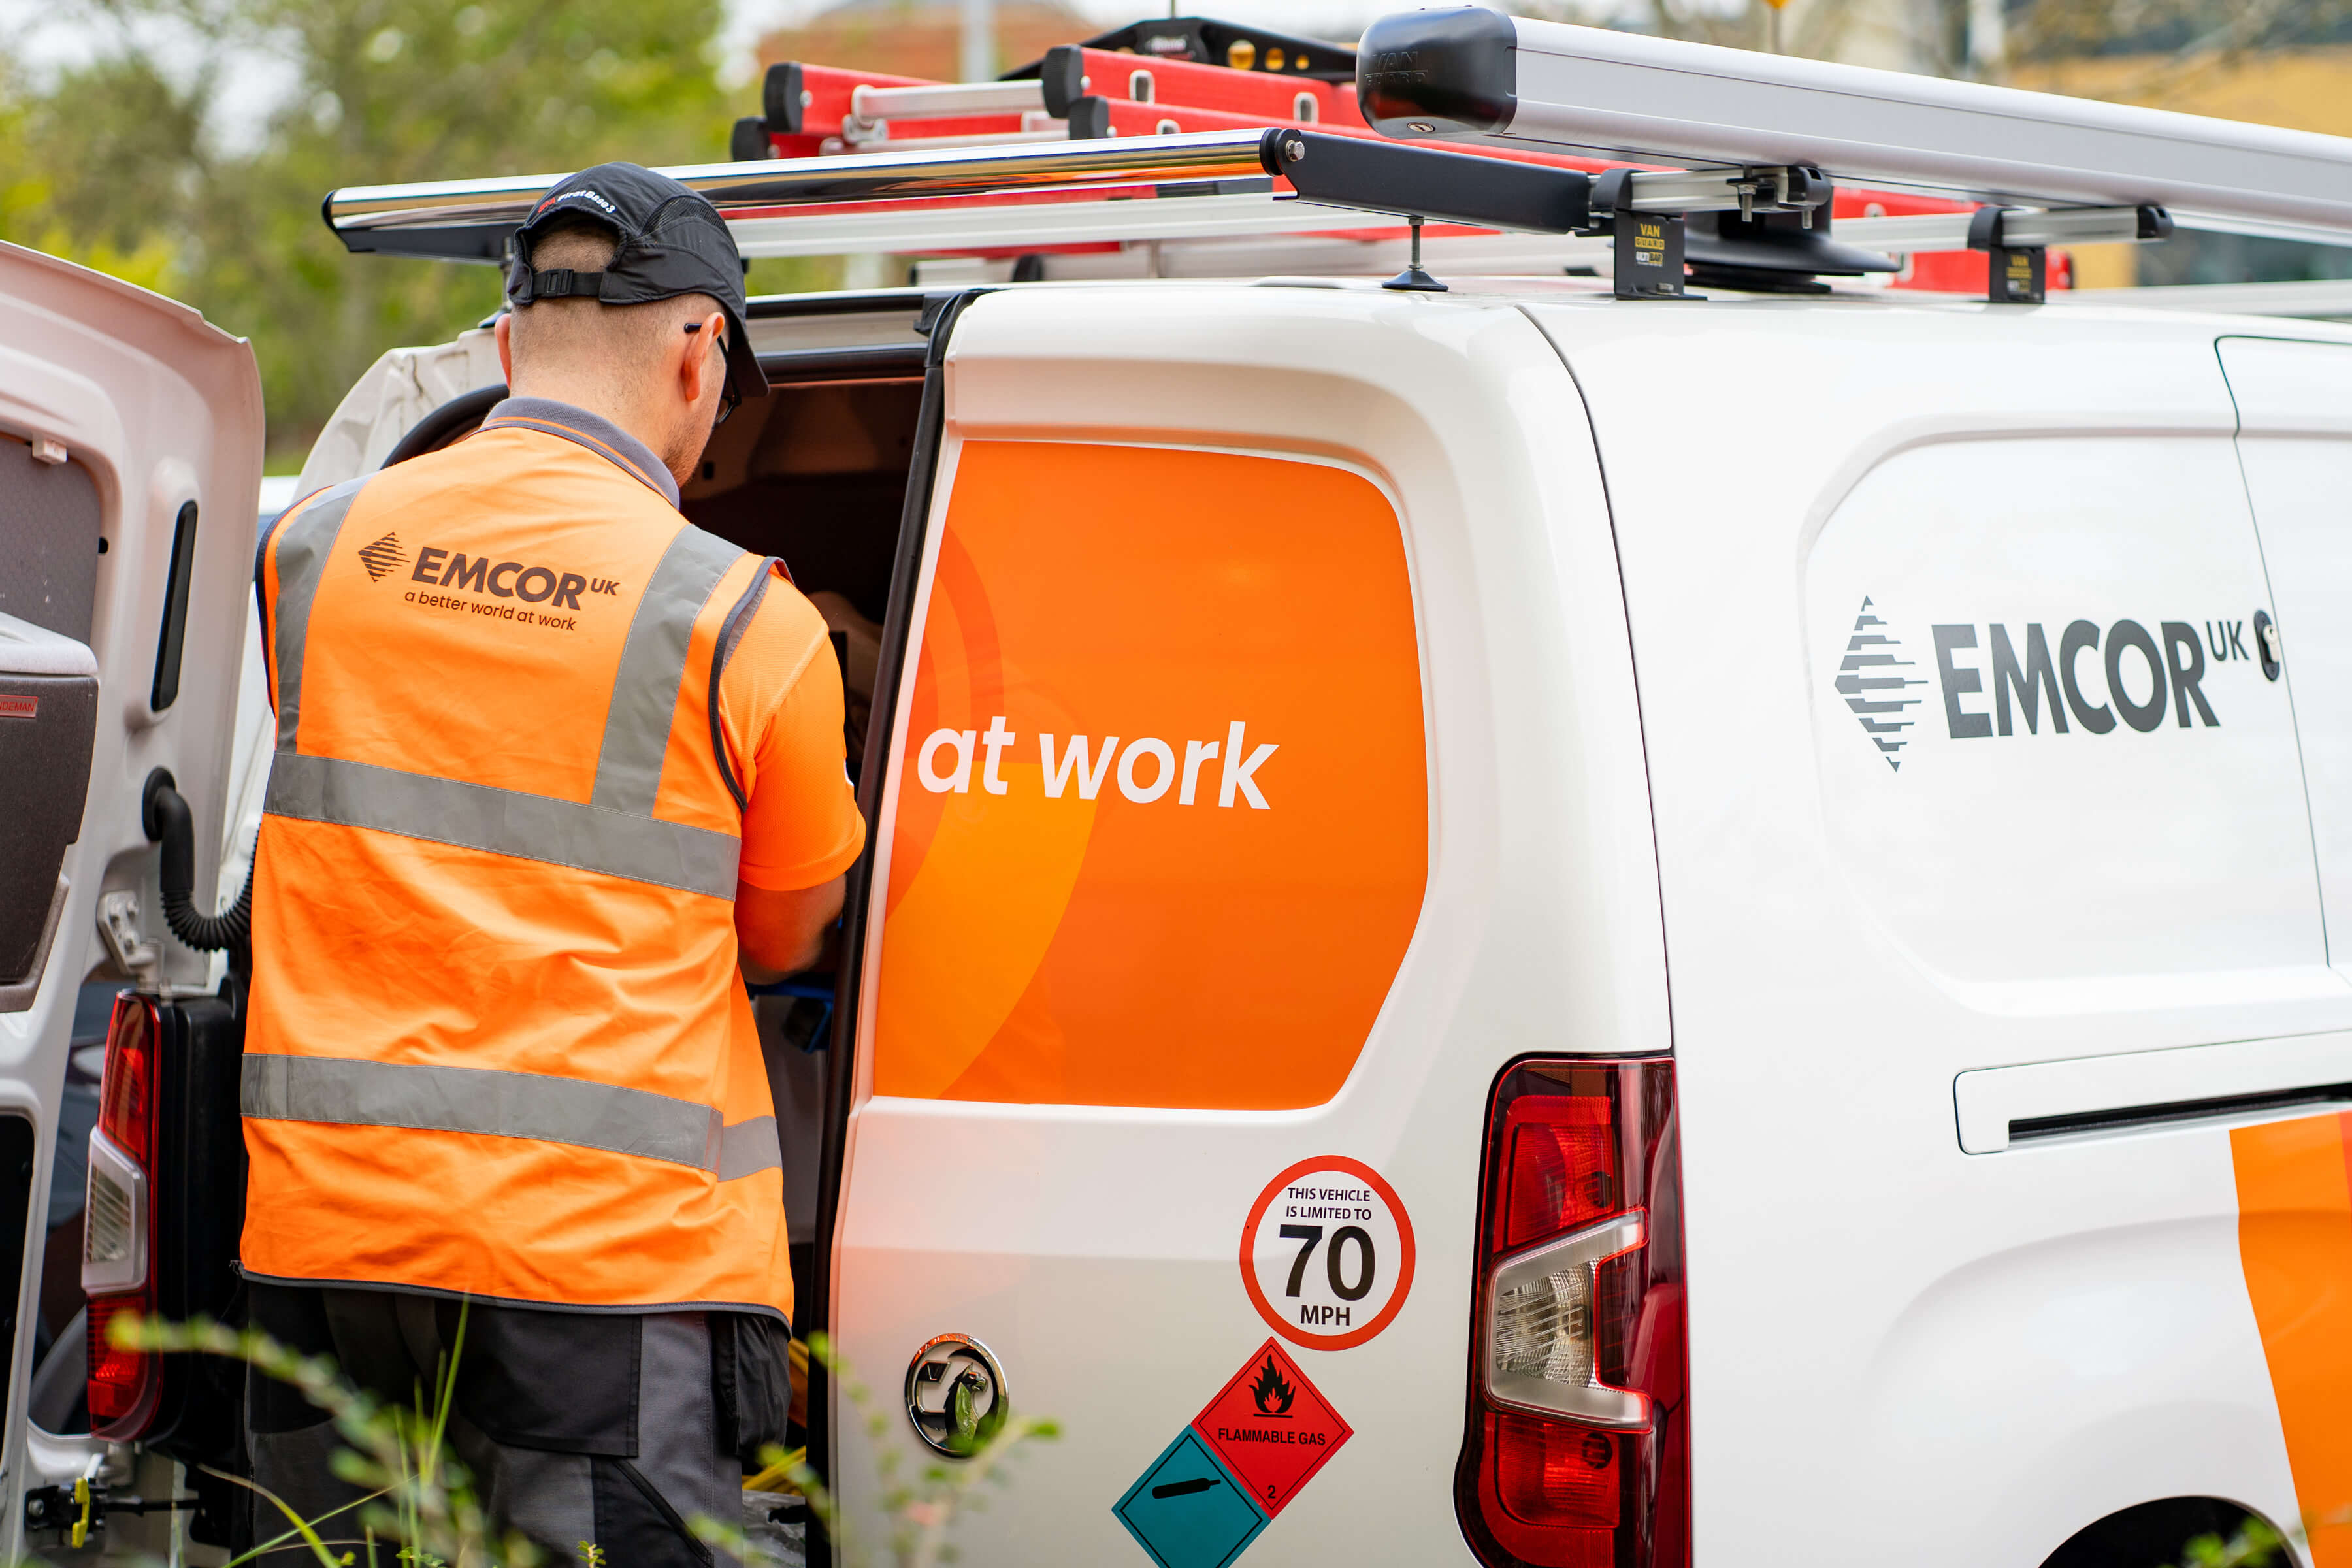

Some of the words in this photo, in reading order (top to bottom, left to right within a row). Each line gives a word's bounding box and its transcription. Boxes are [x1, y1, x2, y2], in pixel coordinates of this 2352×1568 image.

[1640, 223, 1661, 238] VAN
[411, 546, 587, 611] EMCOR
[591, 578, 621, 596] UK
[404, 590, 416, 602] a
[419, 591, 467, 612] better
[471, 605, 514, 620] world
[517, 611, 535, 624] at
[538, 615, 577, 631] work
[1931, 619, 2221, 739] EMCOR
[2206, 620, 2249, 661] UK
[917, 715, 1016, 796] at
[1039, 721, 1280, 810] work
[1287, 1187, 1316, 1200] THIS
[1319, 1188, 1371, 1201] VEHICLE
[1286, 1205, 1297, 1217] IS
[1301, 1207, 1351, 1219] LIMITED
[1354, 1209, 1372, 1220] TO
[1279, 1224, 1375, 1301] 70
[1300, 1305, 1350, 1326] MPH
[1218, 1428, 1296, 1444] FLAMMABLE
[1298, 1432, 1326, 1446] GAS
[1267, 1485, 1276, 1499] 2
